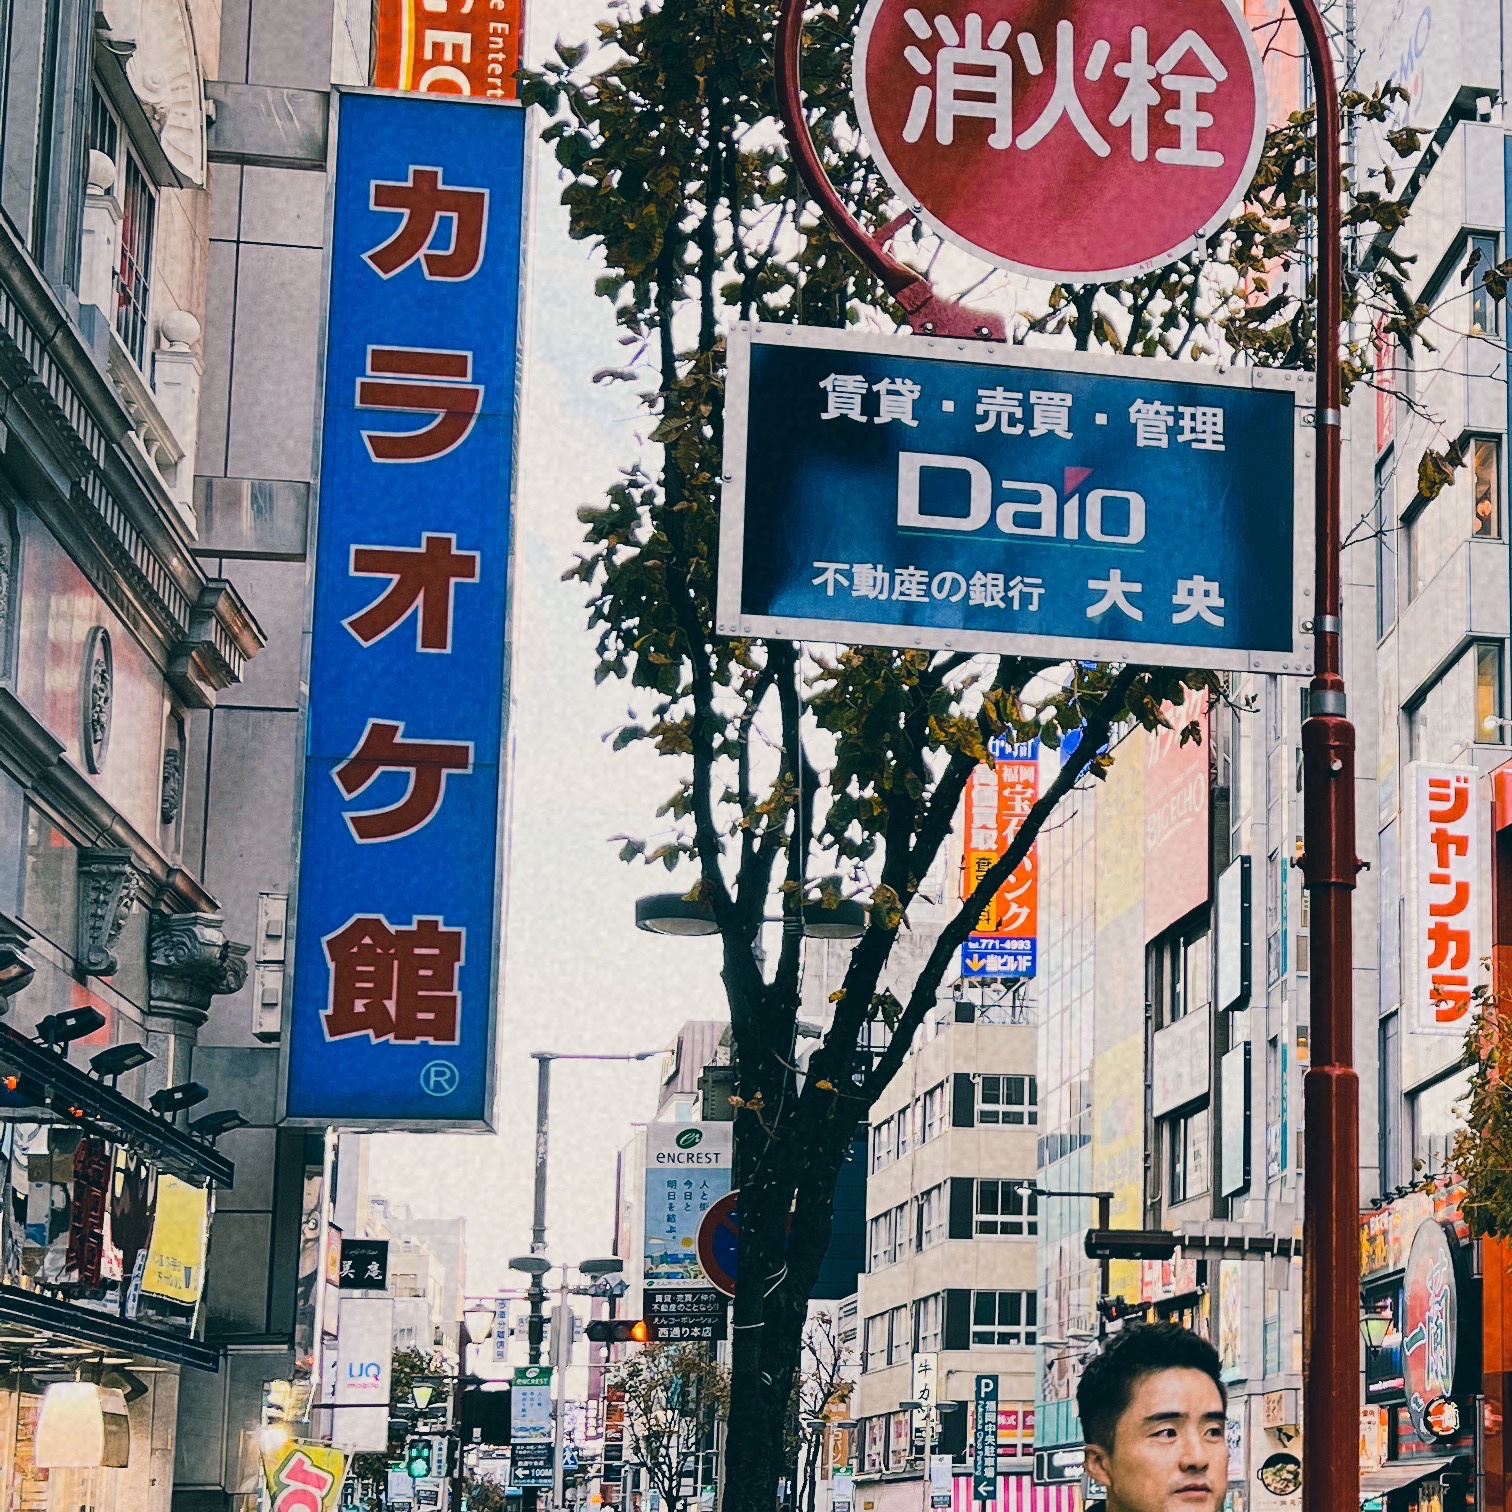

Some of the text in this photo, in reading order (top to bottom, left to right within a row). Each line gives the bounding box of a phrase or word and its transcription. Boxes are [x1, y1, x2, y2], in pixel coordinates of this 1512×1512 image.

[902, 8, 1228, 168] 消火栓
[897, 451, 1146, 545] Daio
[319, 164, 491, 1046] カラオケ館
[812, 561, 1045, 612] 不動産の銀行
[1003, 764, 1035, 783] 福岡
[1427, 775, 1470, 1022] ジャンカラ
[658, 1326, 712, 1338] 西通り本店
[349, 1362, 381, 1381] UQ
[980, 1378, 994, 1398] P
